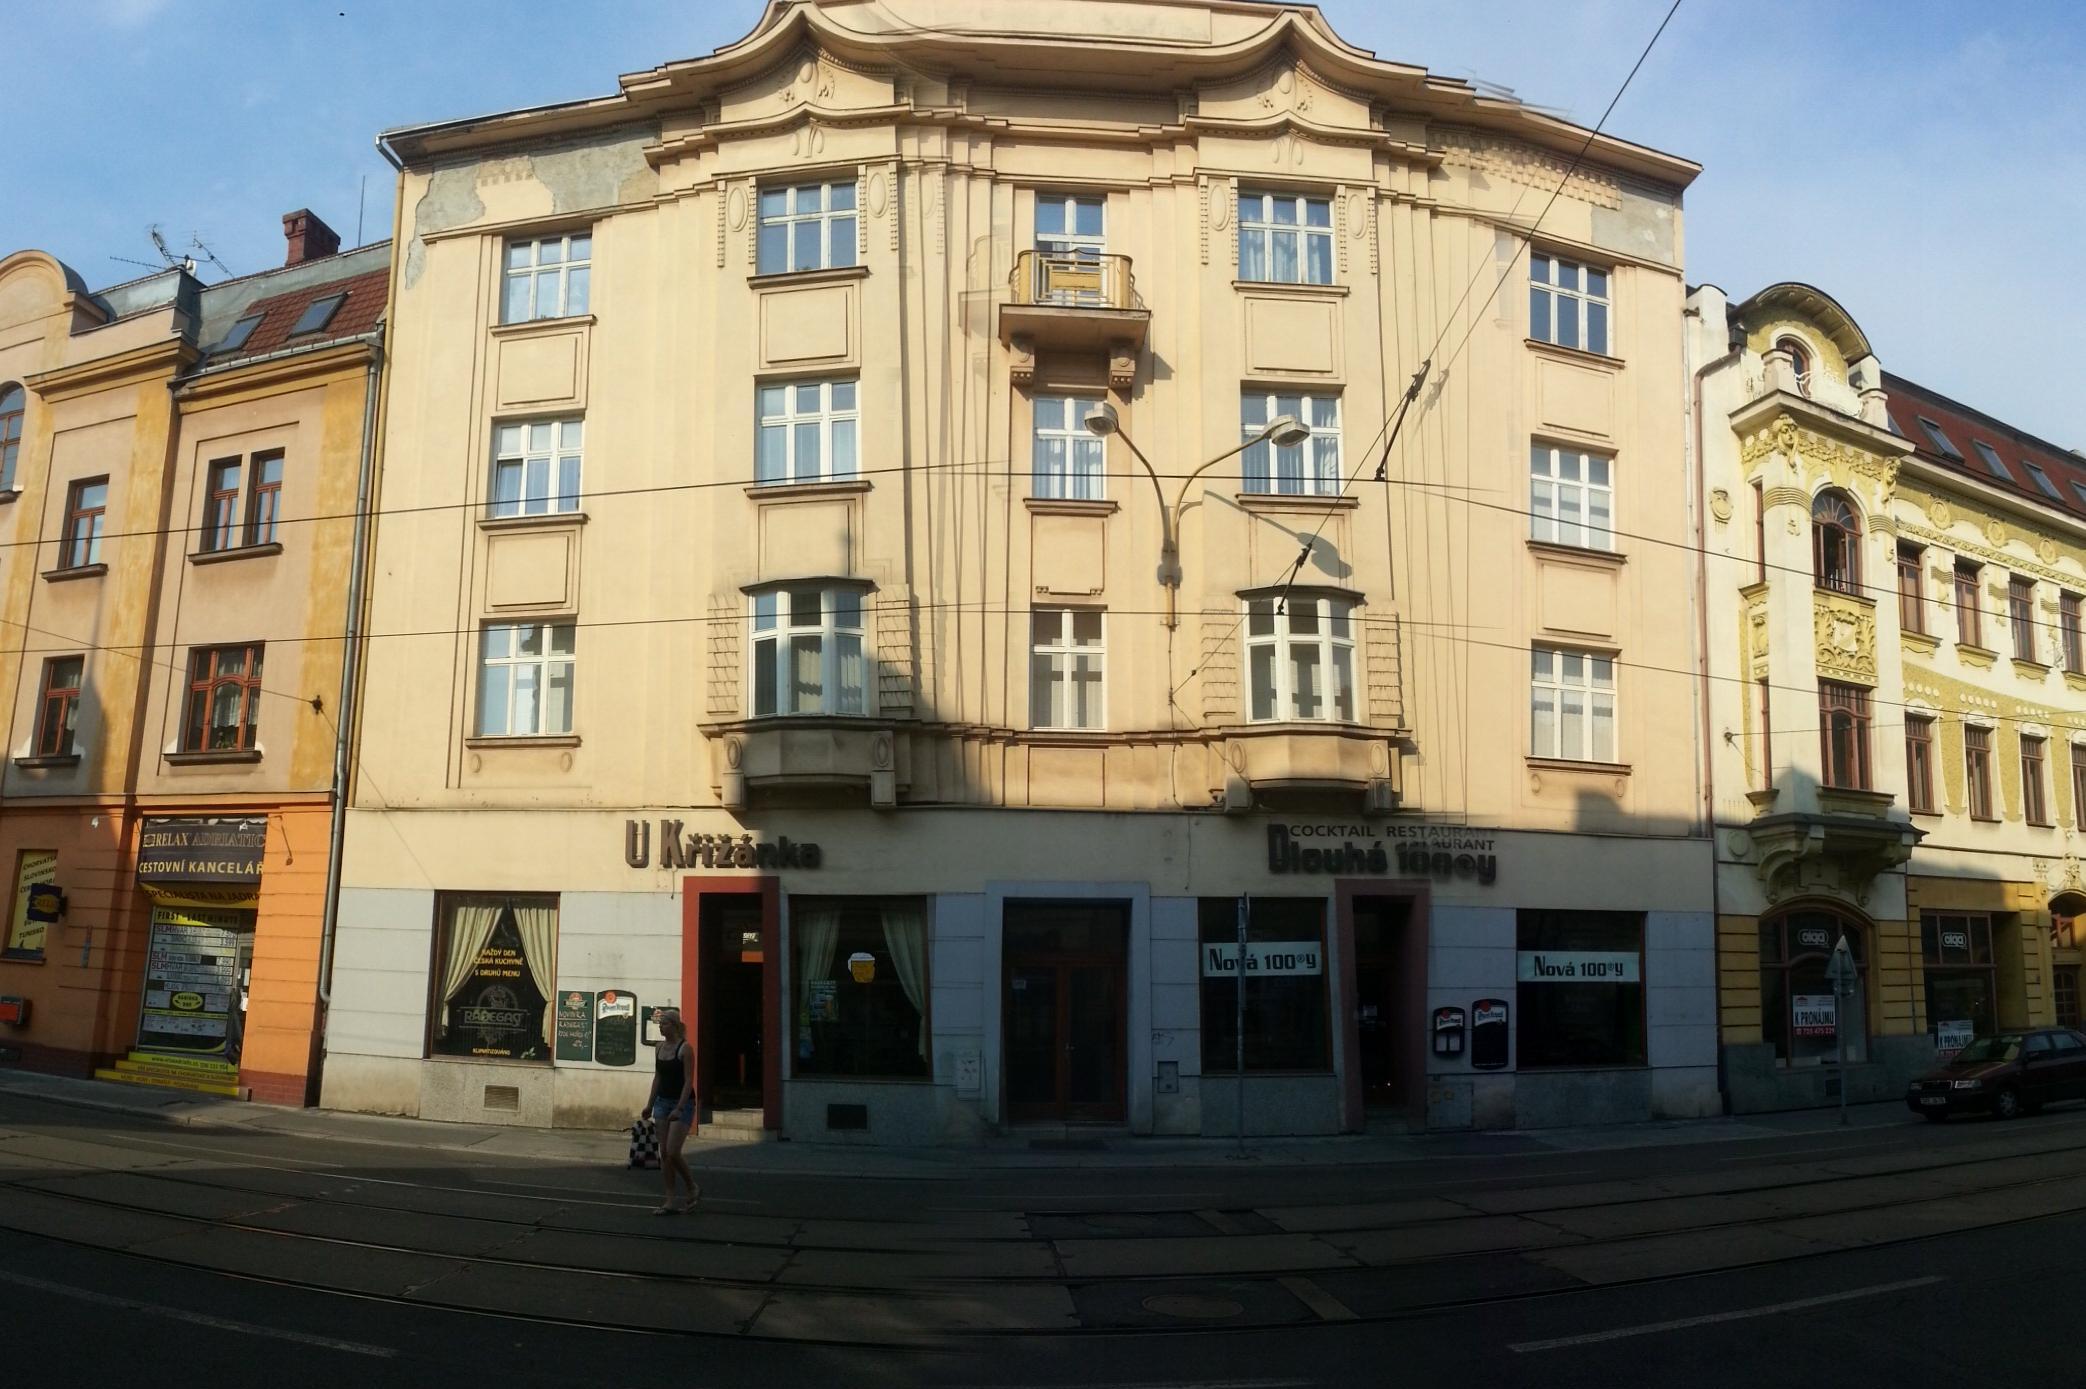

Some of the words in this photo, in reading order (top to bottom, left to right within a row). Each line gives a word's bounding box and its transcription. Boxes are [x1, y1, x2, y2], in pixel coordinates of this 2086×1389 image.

[1290, 825, 1375, 837] COCKTAIL
[155, 832, 188, 847] RELAX
[192, 833, 265, 848] ADRIATIC
[625, 819, 650, 868] U
[1268, 824, 1388, 874] Dlouhá
[138, 859, 185, 873] CESTOVNÍ
[188, 860, 264, 874] KANCELÁŘ
[157, 912, 179, 921] FIRST
[503, 949, 516, 957] DEN
[1534, 955, 1576, 977] Nová
[464, 1009, 525, 1026] RADEGAST
[1795, 1012, 1799, 1025] K
[1800, 1008, 1834, 1025] PRONÁJMU
